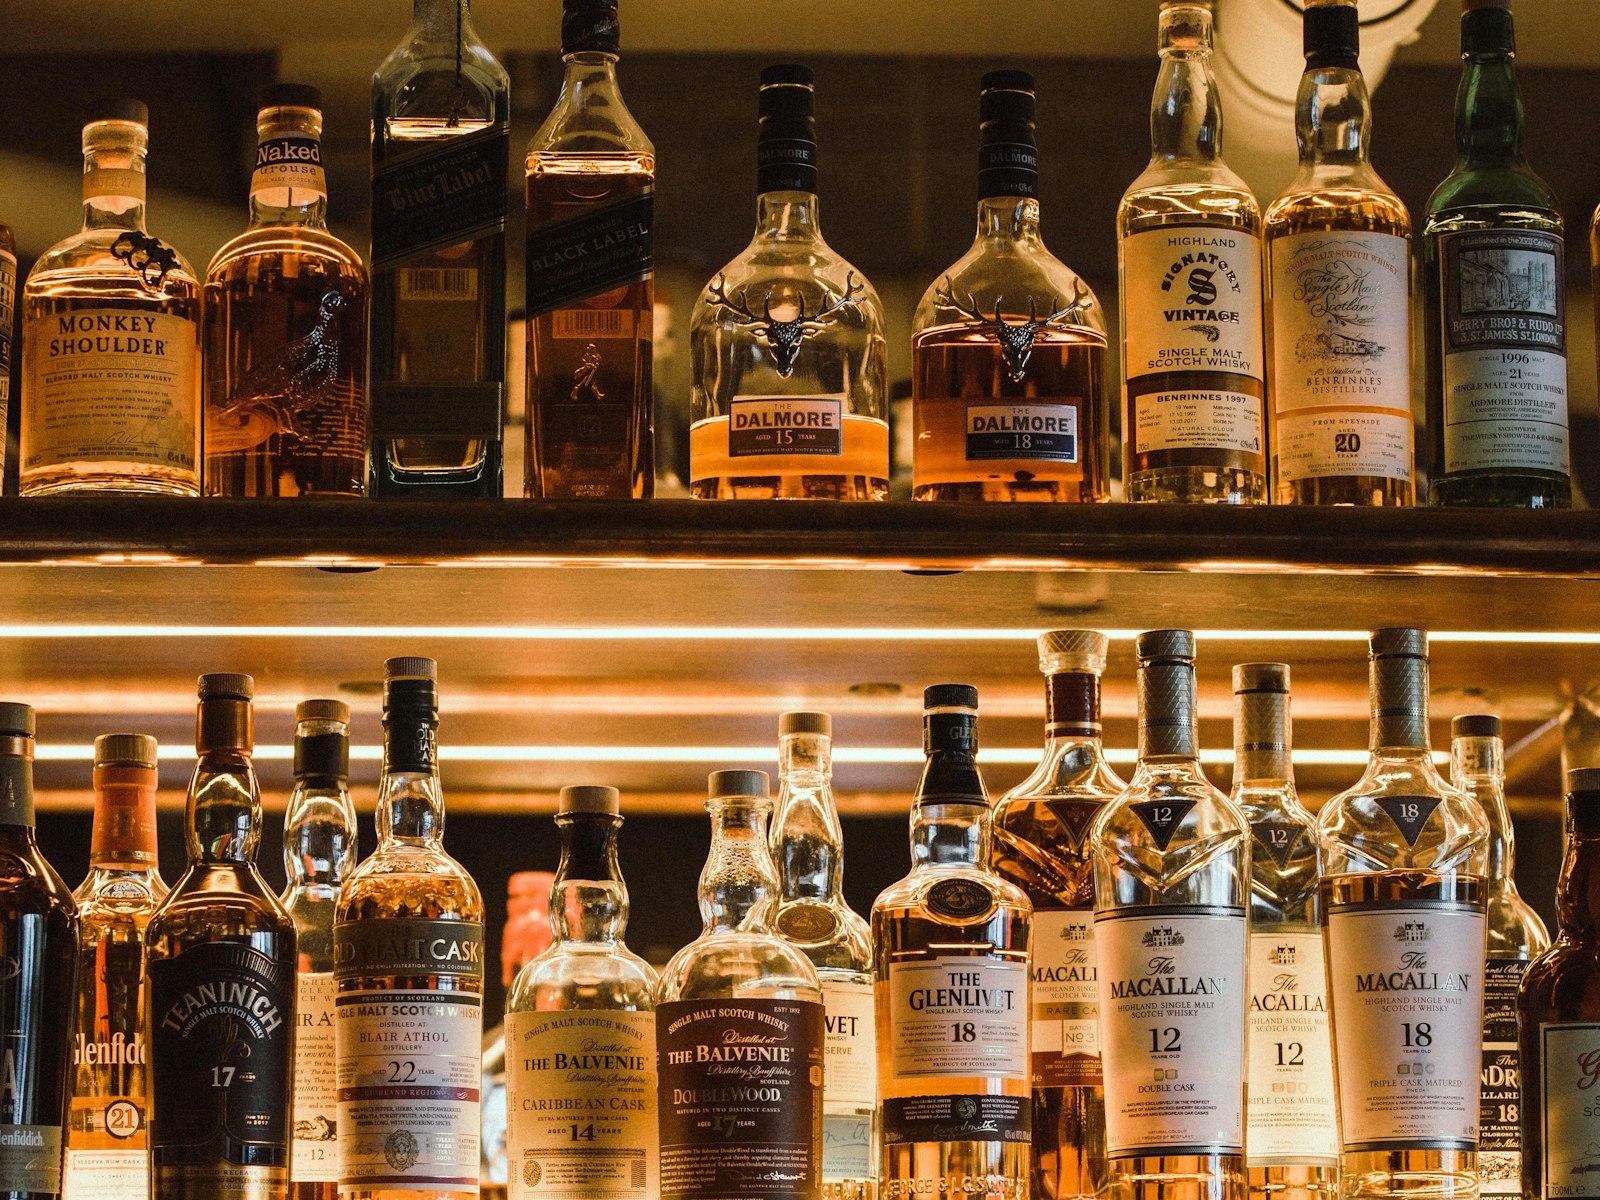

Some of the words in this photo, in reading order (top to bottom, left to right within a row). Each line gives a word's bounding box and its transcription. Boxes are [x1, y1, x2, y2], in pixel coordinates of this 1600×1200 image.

[257, 142, 320, 165] Naked
[532, 242, 589, 271] BLACK
[593, 223, 648, 250] LABEL
[1168, 238, 1235, 248] HIGHLAND
[1311, 251, 1334, 263] MALT
[1336, 250, 1368, 260] SCOTCH
[1371, 255, 1398, 275] WHISKY
[1161, 252, 1240, 294] SIGNATORY
[1163, 309, 1239, 324] VINTAGE
[59, 316, 156, 334] MONKEY
[1453, 319, 1485, 331] BERRY
[1529, 319, 1554, 332] RUDD
[50, 337, 165, 357] SHOULDER
[1158, 348, 1207, 358] SINGLE
[1213, 349, 1242, 359] MALT
[1148, 358, 1201, 368] SCOTCH
[1206, 358, 1251, 370] WHISKY
[1501, 353, 1530, 364] 1996
[143, 374, 172, 383] WHISKY
[1306, 376, 1382, 386] BENRINNES
[1509, 368, 1522, 379] 21
[1312, 386, 1377, 395] DISTILLERY
[1453, 383, 1483, 393] SINGLE
[1484, 381, 1508, 389] MALT
[1510, 382, 1542, 390] SCOTCH
[1157, 394, 1222, 402] BENRINNES
[1226, 395, 1246, 403] 1997
[1470, 399, 1513, 407] ARDMORE
[1514, 399, 1556, 409] DISTILLERY
[735, 412, 833, 428] DALMORE
[973, 416, 1069, 432] DALMORE
[776, 429, 793, 444] 15
[1014, 434, 1031, 449] 18
[1335, 433, 1360, 453] 20
[1152, 807, 1172, 822] 12
[1400, 803, 1419, 818] 18
[1269, 829, 1288, 844] 12
[429, 939, 479, 963] CASK
[1064, 949, 1088, 965] The
[1145, 957, 1175, 975] The
[1398, 951, 1428, 970] The
[948, 972, 981, 986] THE
[1270, 974, 1298, 992] The
[1356, 972, 1469, 992] MACALLAN
[1110, 977, 1223, 999] MACALLAN
[909, 989, 1014, 1010] GLENLIVET
[1118, 1003, 1157, 1012] HIGHLAND
[1365, 997, 1409, 1005] HIGHLAND
[161, 981, 282, 1036] TEANINICH
[357, 1006, 388, 1016] MALT
[392, 1005, 444, 1016] SCOTCH
[1046, 1007, 1078, 1015] RARE
[1131, 1011, 1163, 1019] SCOTCH
[200, 1006, 217, 1019] MALT
[219, 1005, 246, 1018] SCOTCH
[246, 1014, 265, 1039] WHISKY
[668, 1015, 692, 1034] SINGLE
[693, 1009, 716, 1020] MALT
[719, 1008, 755, 1019] SCOTCH
[757, 1012, 790, 1032] WHISKY
[360, 1032, 397, 1042] BLAIR
[403, 1032, 448, 1042] ATHOL
[524, 1024, 550, 1041] SINGLE
[551, 1018, 575, 1029] MALT
[577, 1018, 612, 1028] SCOTCH
[615, 1022, 645, 1041] WHISKY
[951, 1022, 976, 1043] 18
[1401, 1022, 1432, 1047] 18
[1148, 1028, 1181, 1053] 12
[523, 1059, 550, 1071] THE
[554, 1053, 645, 1070] BALVENIE
[668, 1051, 693, 1064] THE
[696, 1045, 790, 1062] BALVENIE
[1274, 1042, 1304, 1066] 12
[1496, 1055, 1518, 1066] The
[211, 1066, 236, 1087] 17
[387, 1061, 417, 1083] 22
[1138, 1084, 1171, 1093] DOUBLE
[1173, 1084, 1195, 1092] CASK
[1369, 1080, 1397, 1088] TRIPLE
[522, 1098, 606, 1110] CARIBBEAN
[609, 1097, 645, 1110] CASK
[111, 1108, 135, 1129] 21
[1498, 1104, 1518, 1122] 18
[569, 1123, 597, 1141] 14
[713, 1115, 737, 1137] 17
[311, 1149, 324, 1160] 12
[1552, 1185, 1573, 1195] 700ML
